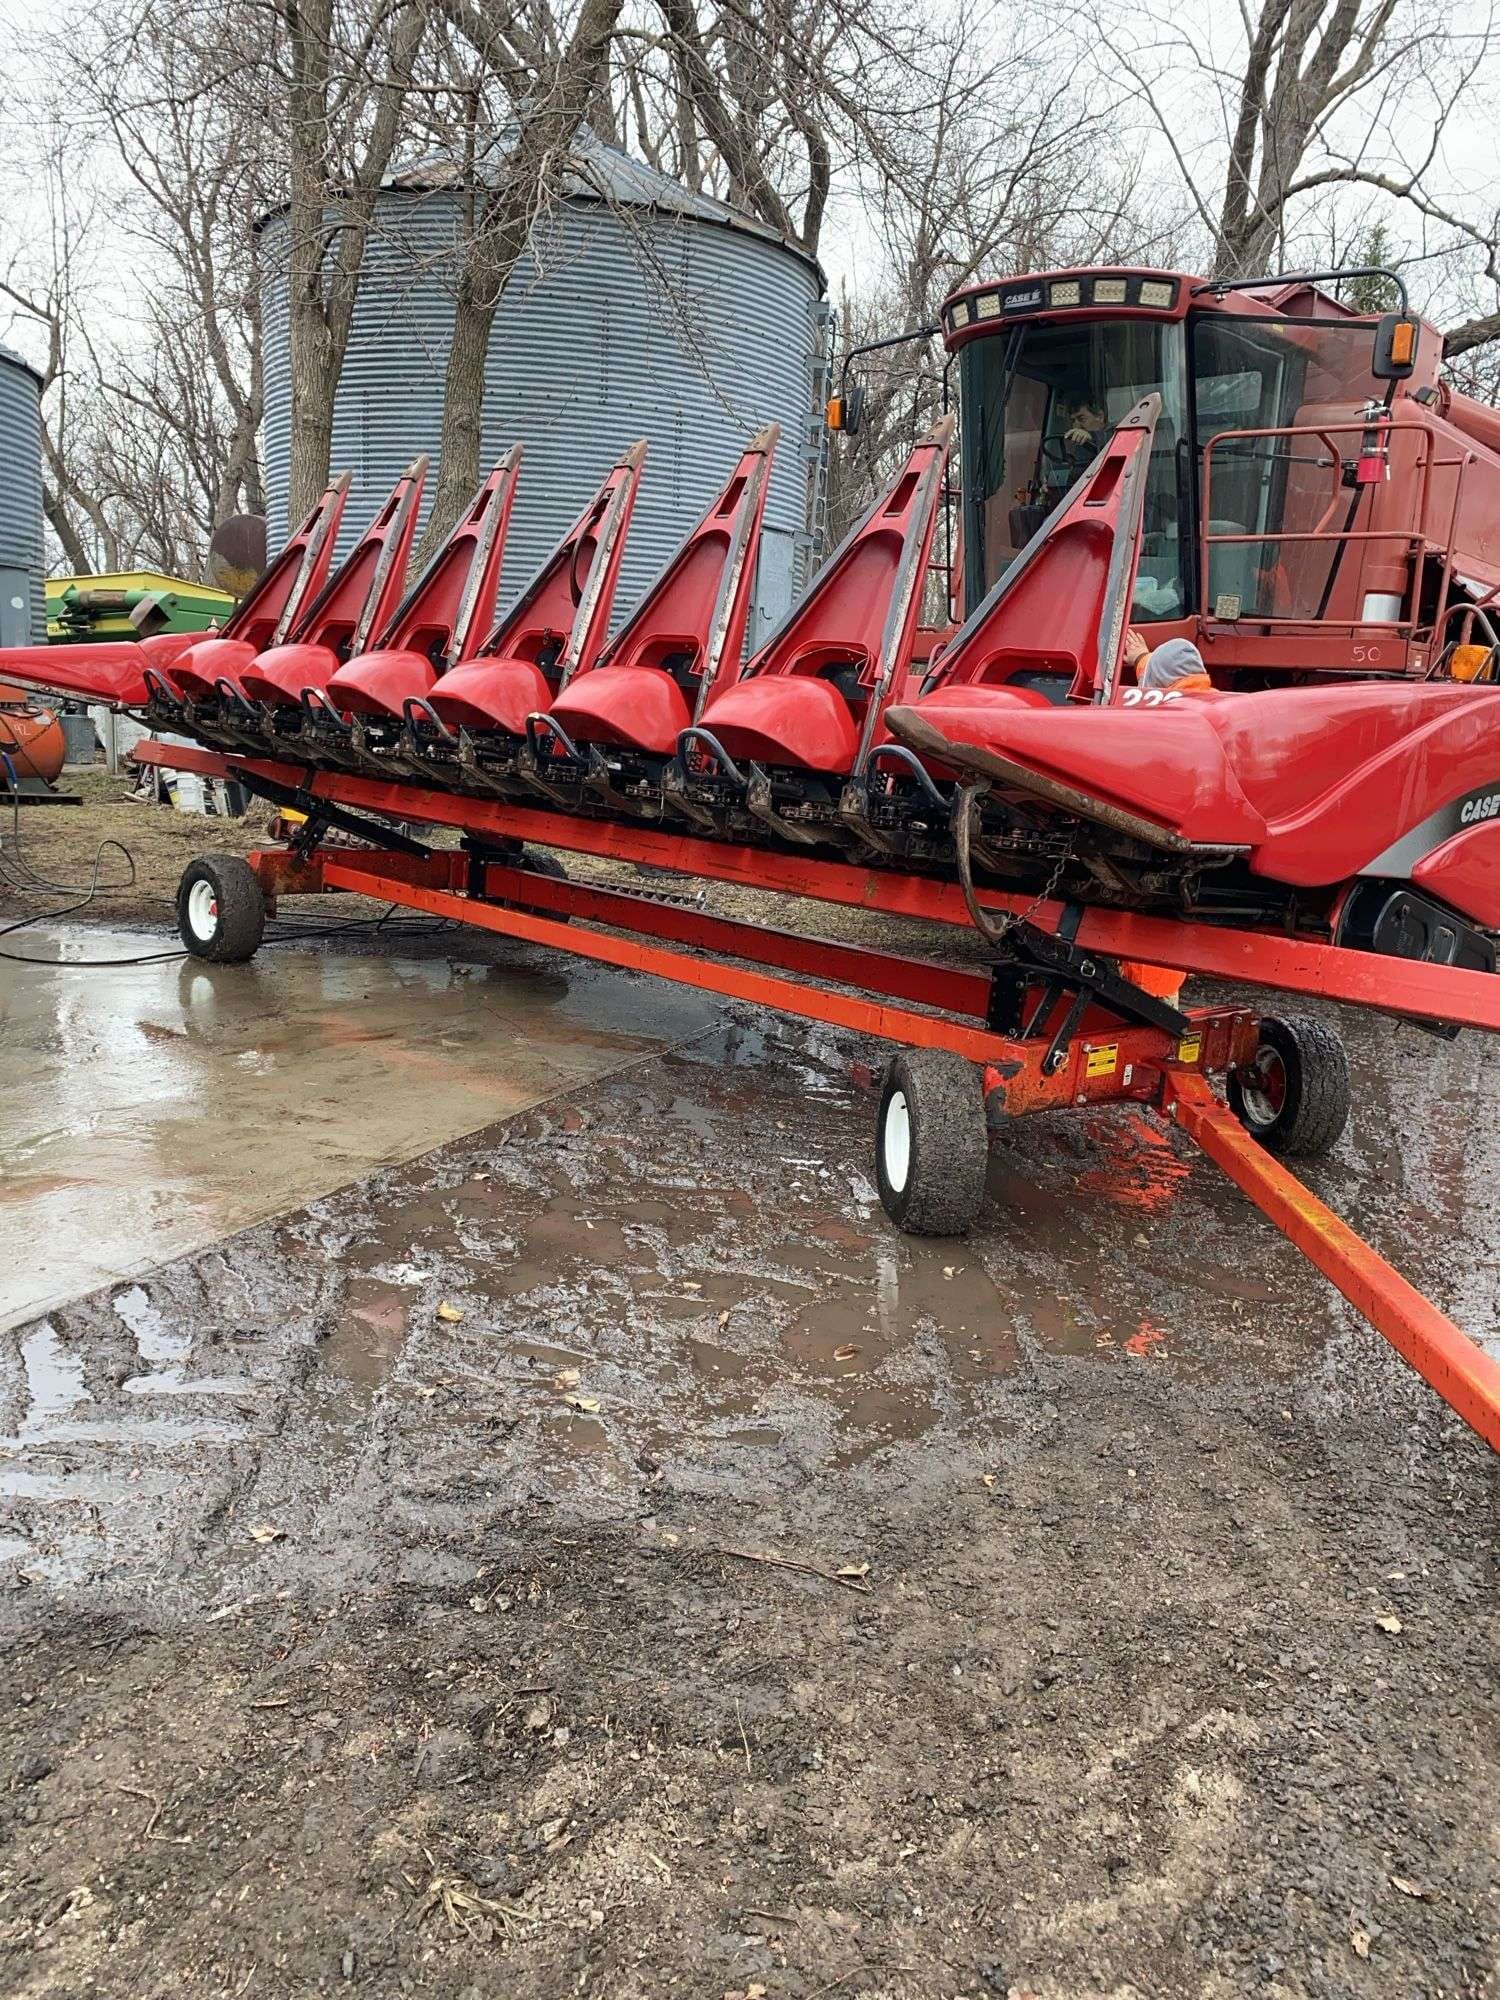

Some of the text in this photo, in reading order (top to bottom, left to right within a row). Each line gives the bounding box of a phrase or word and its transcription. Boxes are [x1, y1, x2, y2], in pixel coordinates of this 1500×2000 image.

[1004, 292, 1031, 304] CASE
[1351, 645, 1381, 662] 50
[1460, 793, 1500, 823] CASE
